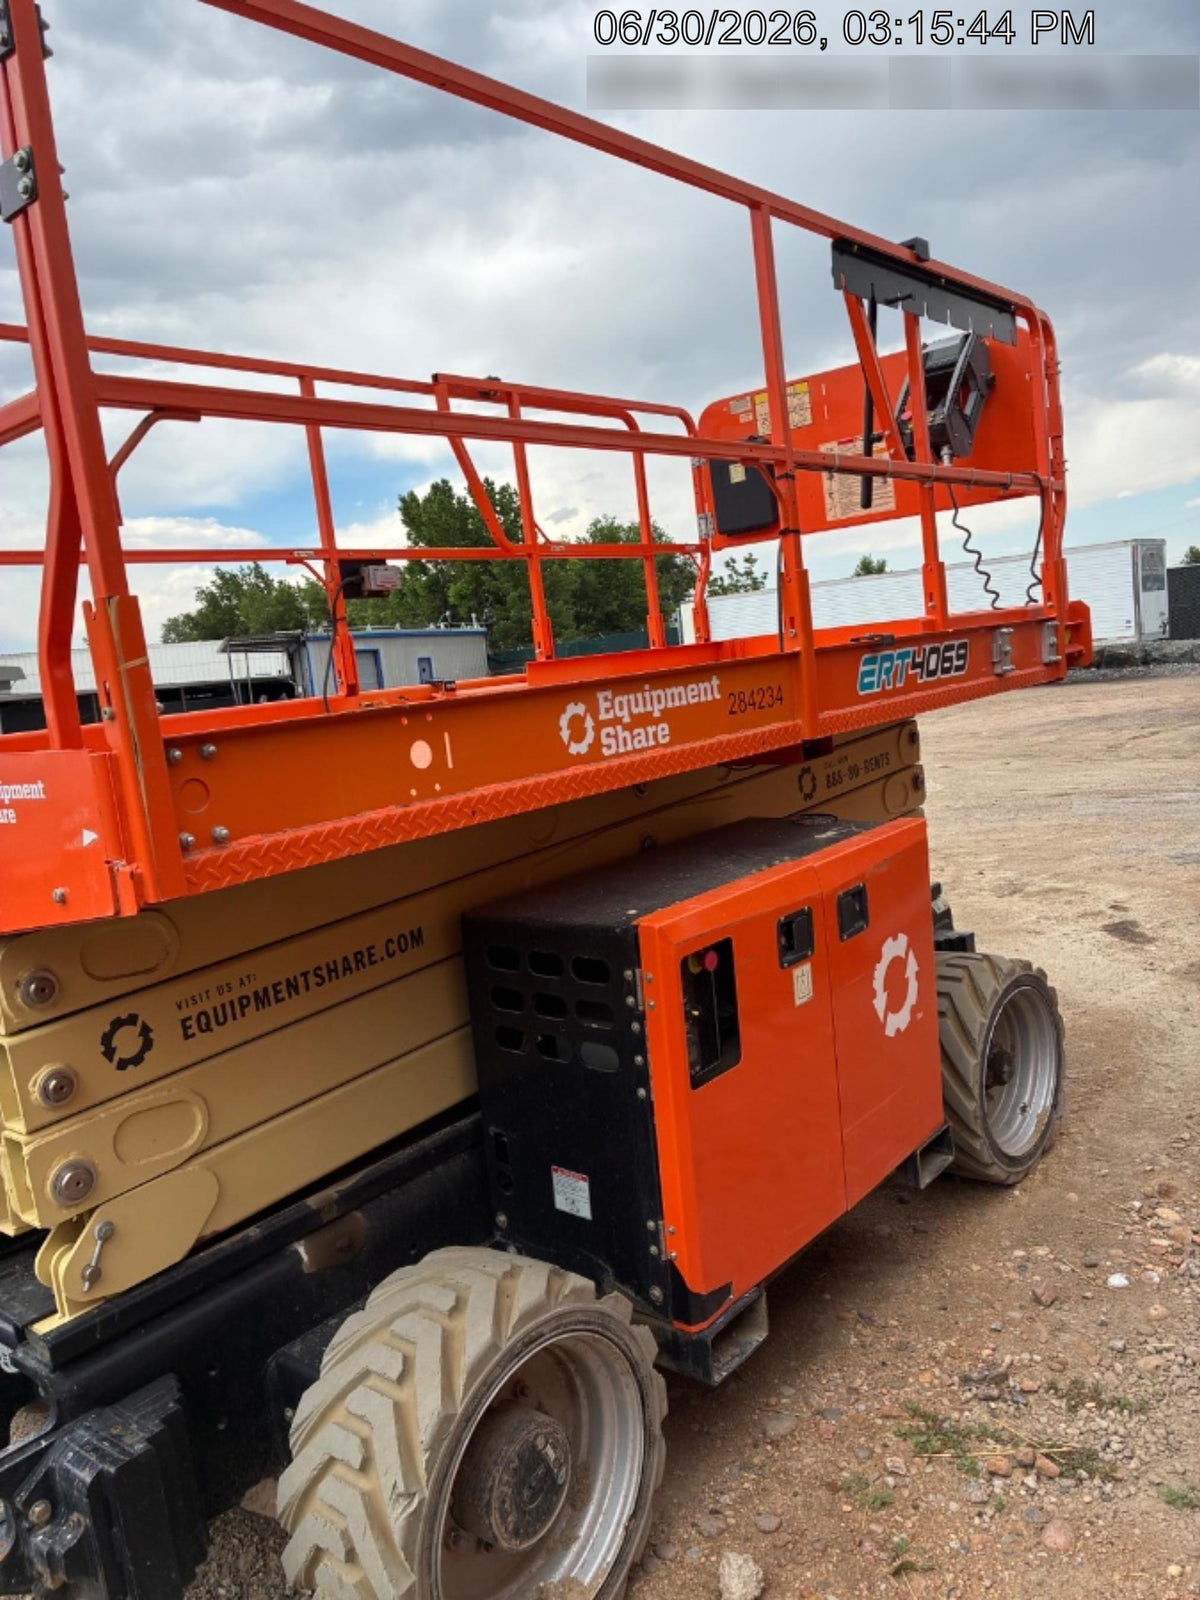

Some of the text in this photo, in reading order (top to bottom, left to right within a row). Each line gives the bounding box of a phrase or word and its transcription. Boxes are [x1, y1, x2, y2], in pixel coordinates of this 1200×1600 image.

[597, 675, 721, 723] Equipment
[728, 684, 784, 716] 284234
[600, 722, 670, 757] Share
[176, 974, 257, 1010] VISIT US AT:
[180, 926, 424, 1040] EQUIPMENTSHARE.COM
